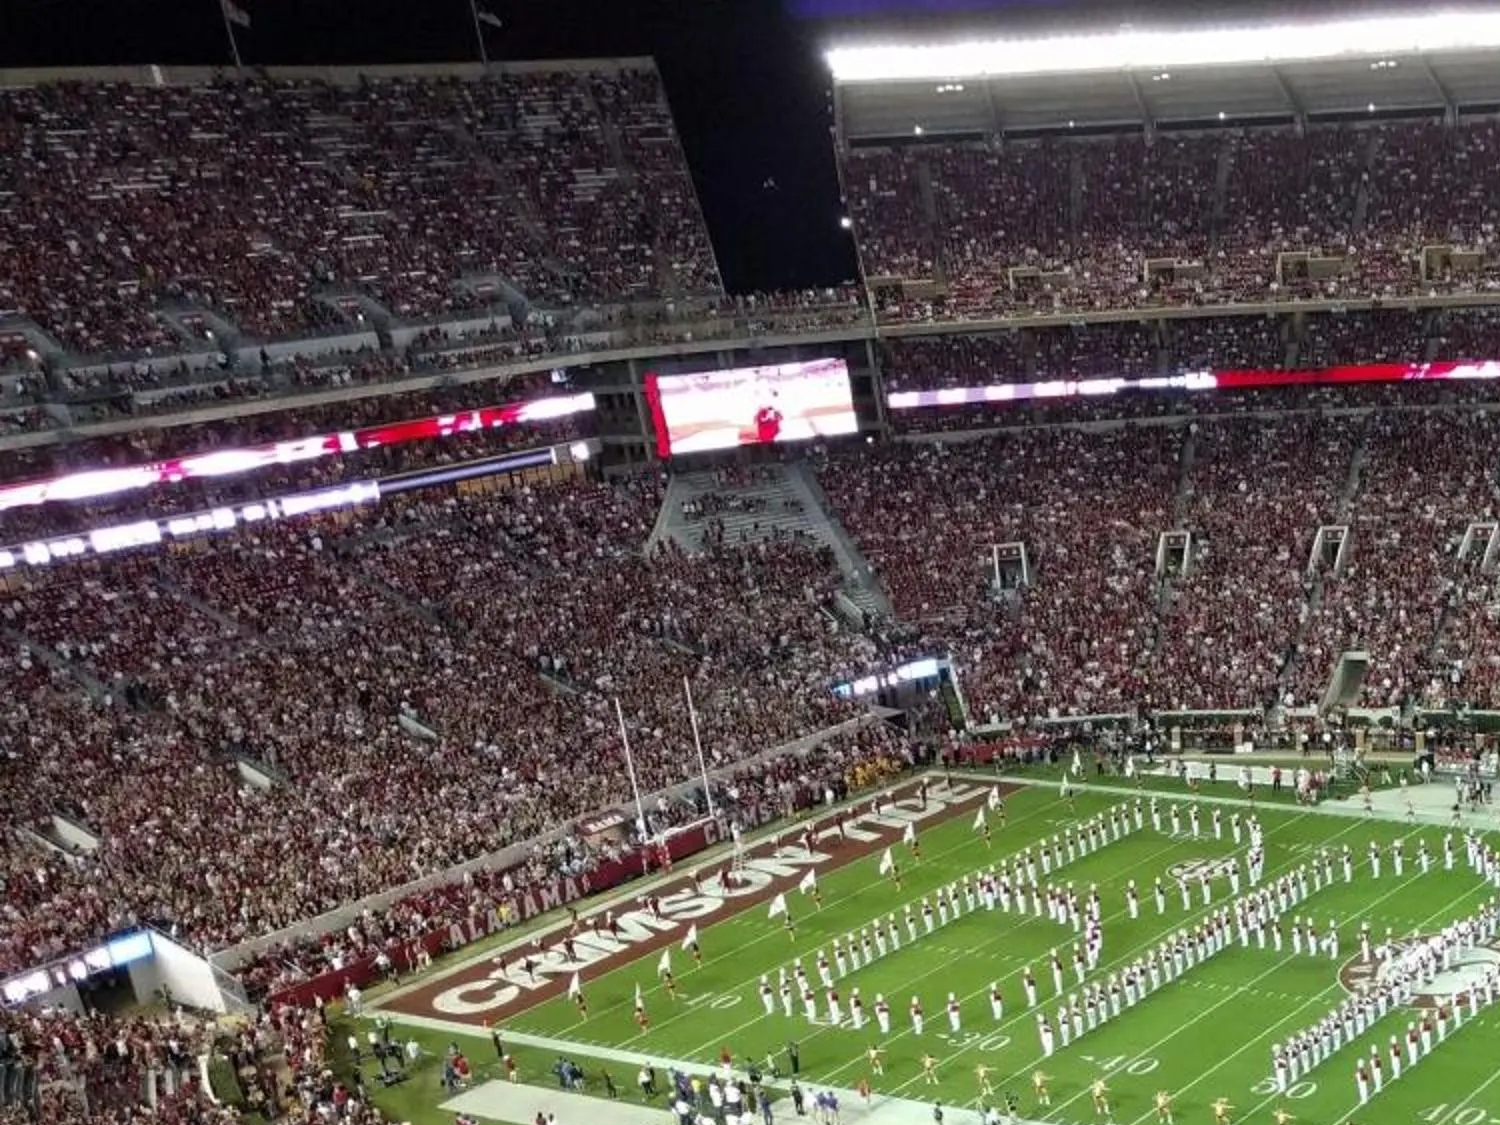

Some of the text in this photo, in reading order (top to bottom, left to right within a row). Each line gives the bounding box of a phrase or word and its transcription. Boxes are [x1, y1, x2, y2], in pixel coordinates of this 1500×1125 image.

[432, 780, 991, 1014] CRIMSON TIDE
[450, 877, 581, 948] ALABAMA
[684, 991, 742, 1009] 10
[946, 1032, 1012, 1052] 30
[1095, 1055, 1159, 1075] 40
[1250, 1076, 1317, 1099] 50
